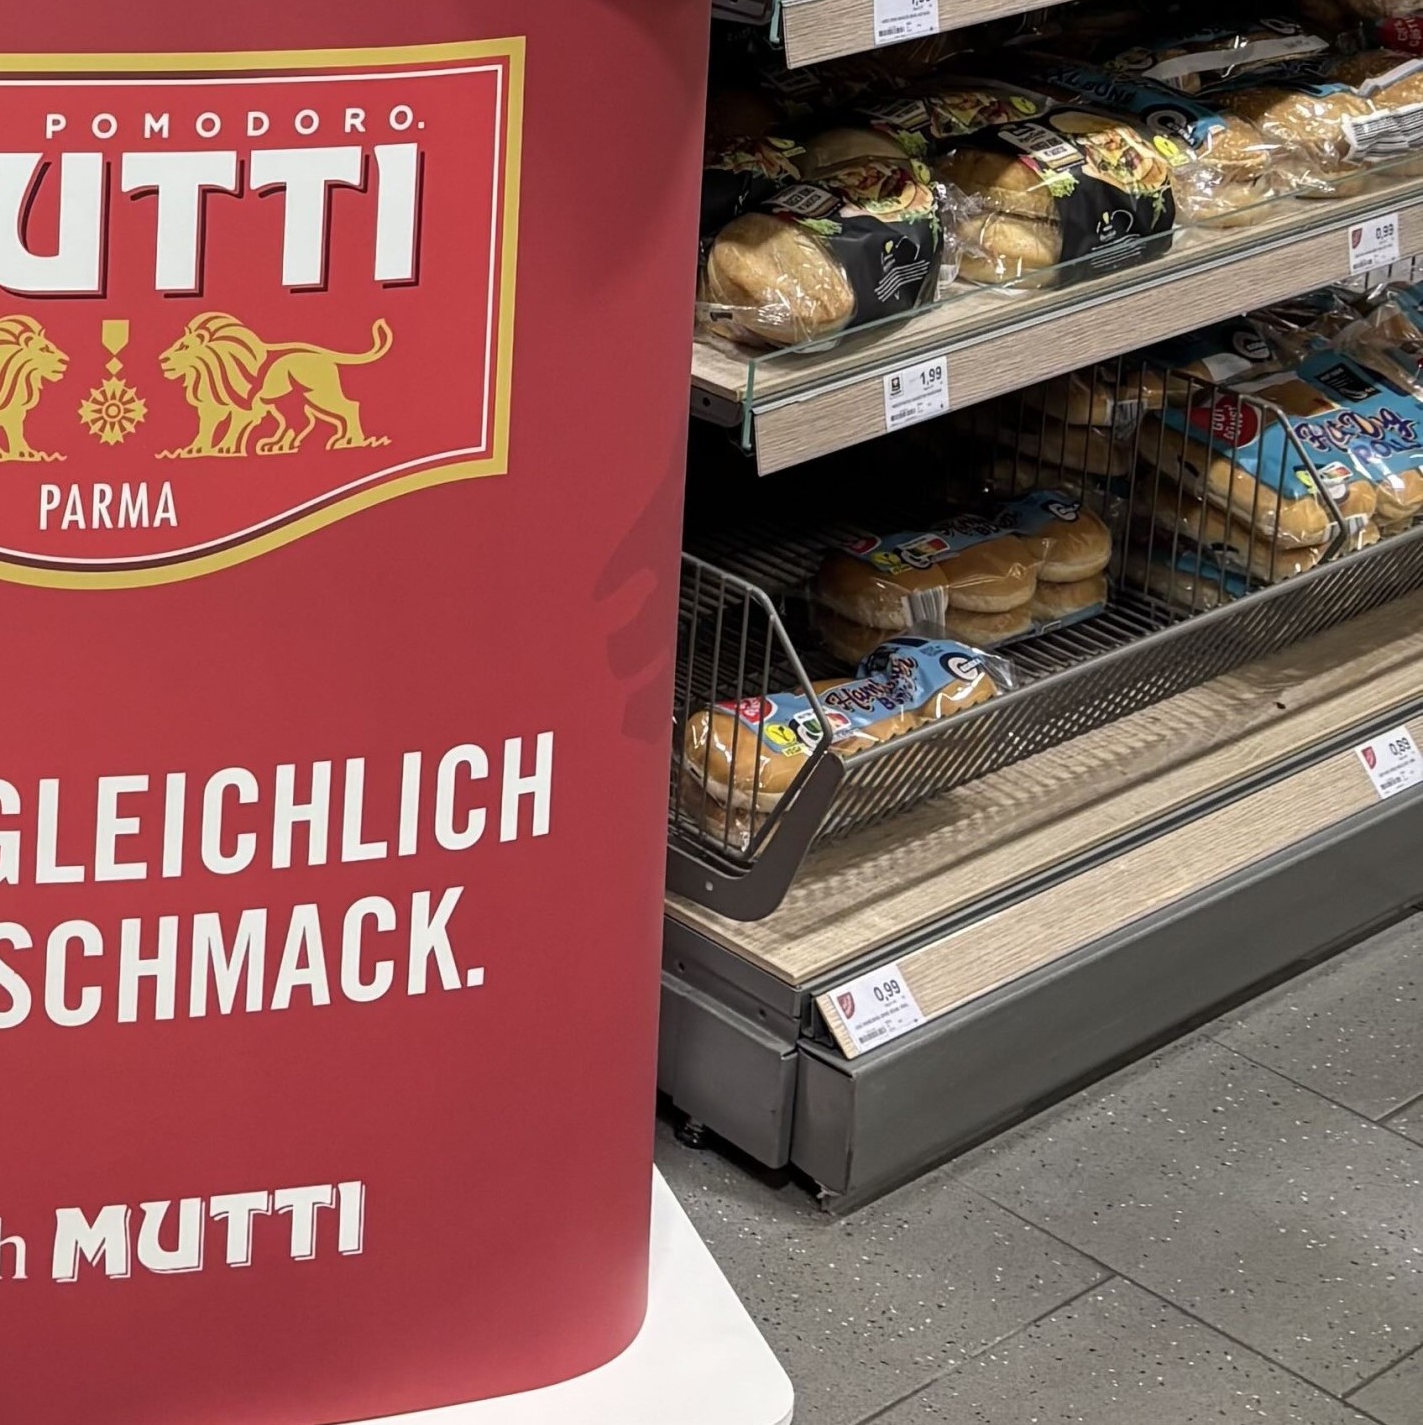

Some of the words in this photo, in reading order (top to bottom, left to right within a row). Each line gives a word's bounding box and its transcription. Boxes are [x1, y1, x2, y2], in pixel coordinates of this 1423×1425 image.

[46, 104, 426, 141] POMODORO.
[919, 366, 943, 386] 1,99
[38, 480, 179, 532] PARMA
[873, 979, 901, 1002] 0,99
[51, 1179, 366, 1283] MUTTI
